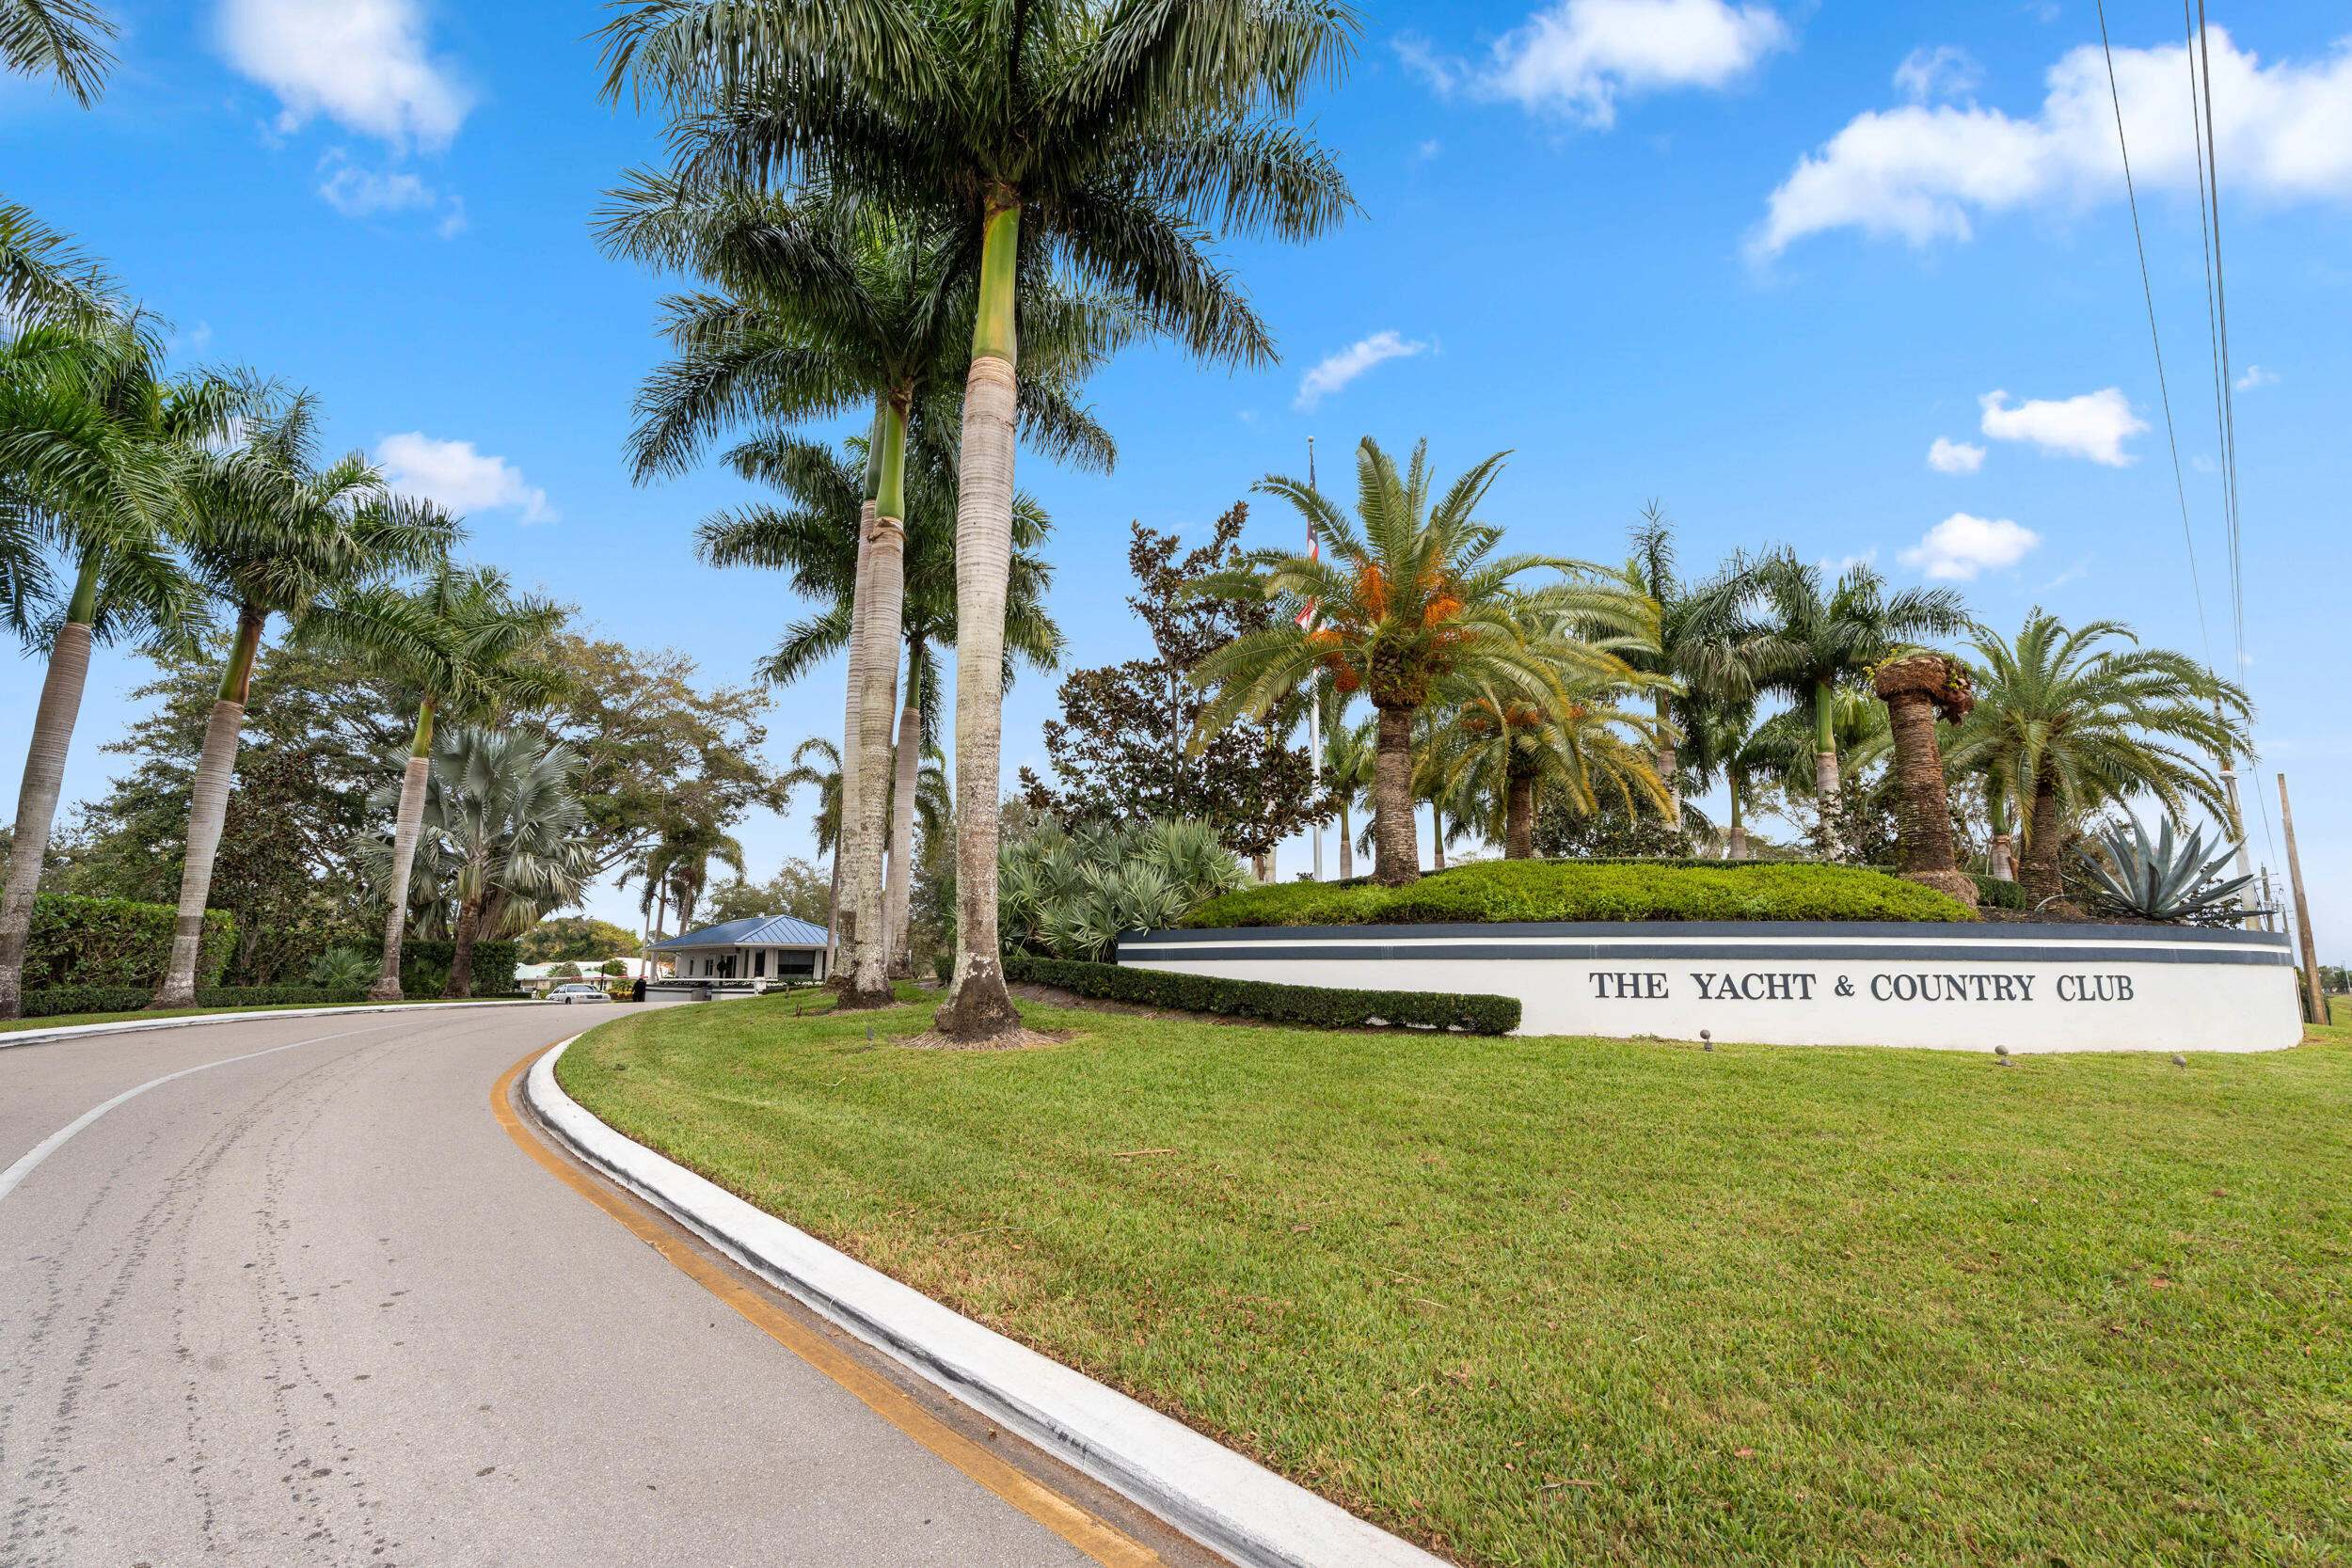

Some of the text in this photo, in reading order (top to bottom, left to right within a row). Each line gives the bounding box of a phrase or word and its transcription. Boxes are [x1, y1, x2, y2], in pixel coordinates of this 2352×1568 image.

[1589, 972, 2134, 1002] THE YACHT & COUNTRY CLUB
